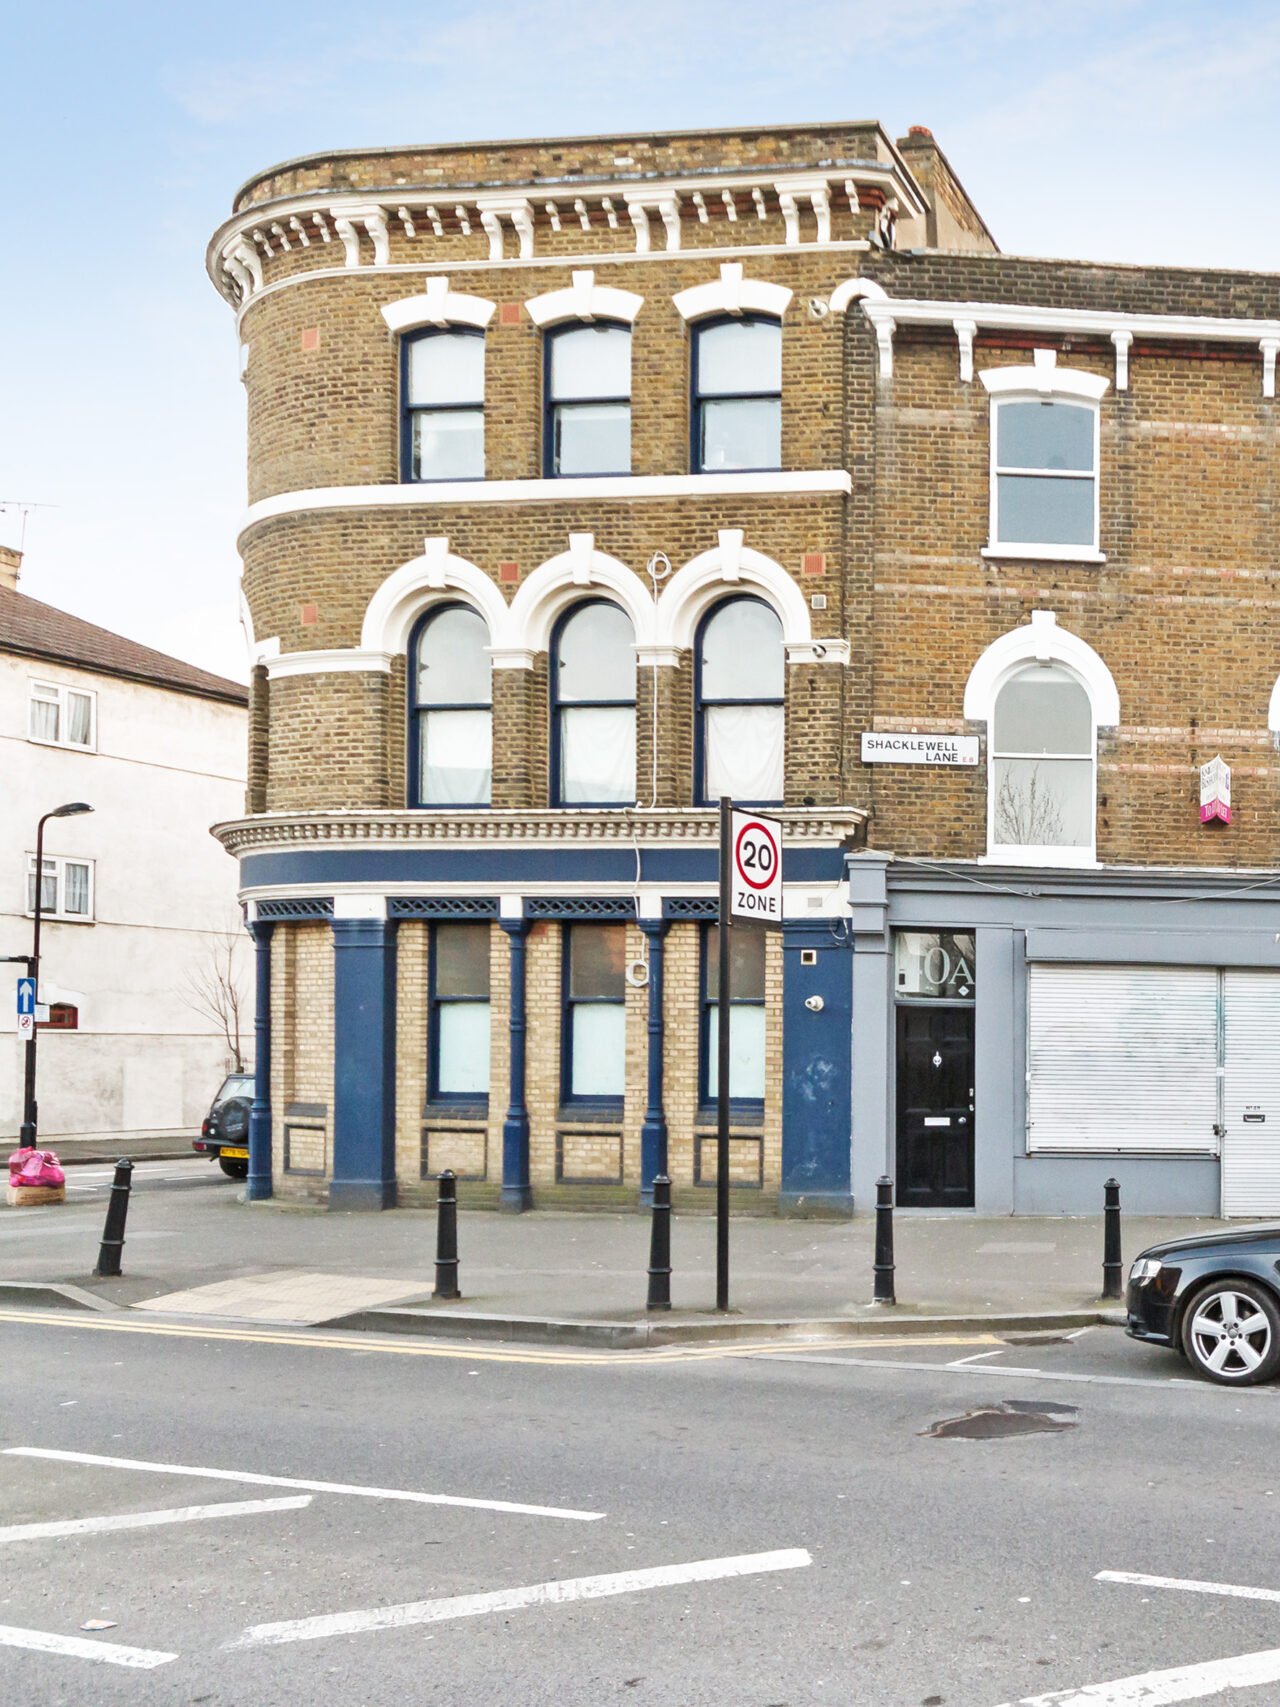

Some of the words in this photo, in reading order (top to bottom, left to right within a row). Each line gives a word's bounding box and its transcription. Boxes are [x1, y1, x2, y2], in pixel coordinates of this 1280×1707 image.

[867, 740, 958, 752] SHACKLEWELL
[926, 752, 958, 763] LANE
[743, 841, 772, 871] 20
[738, 892, 776, 913] ZONE
